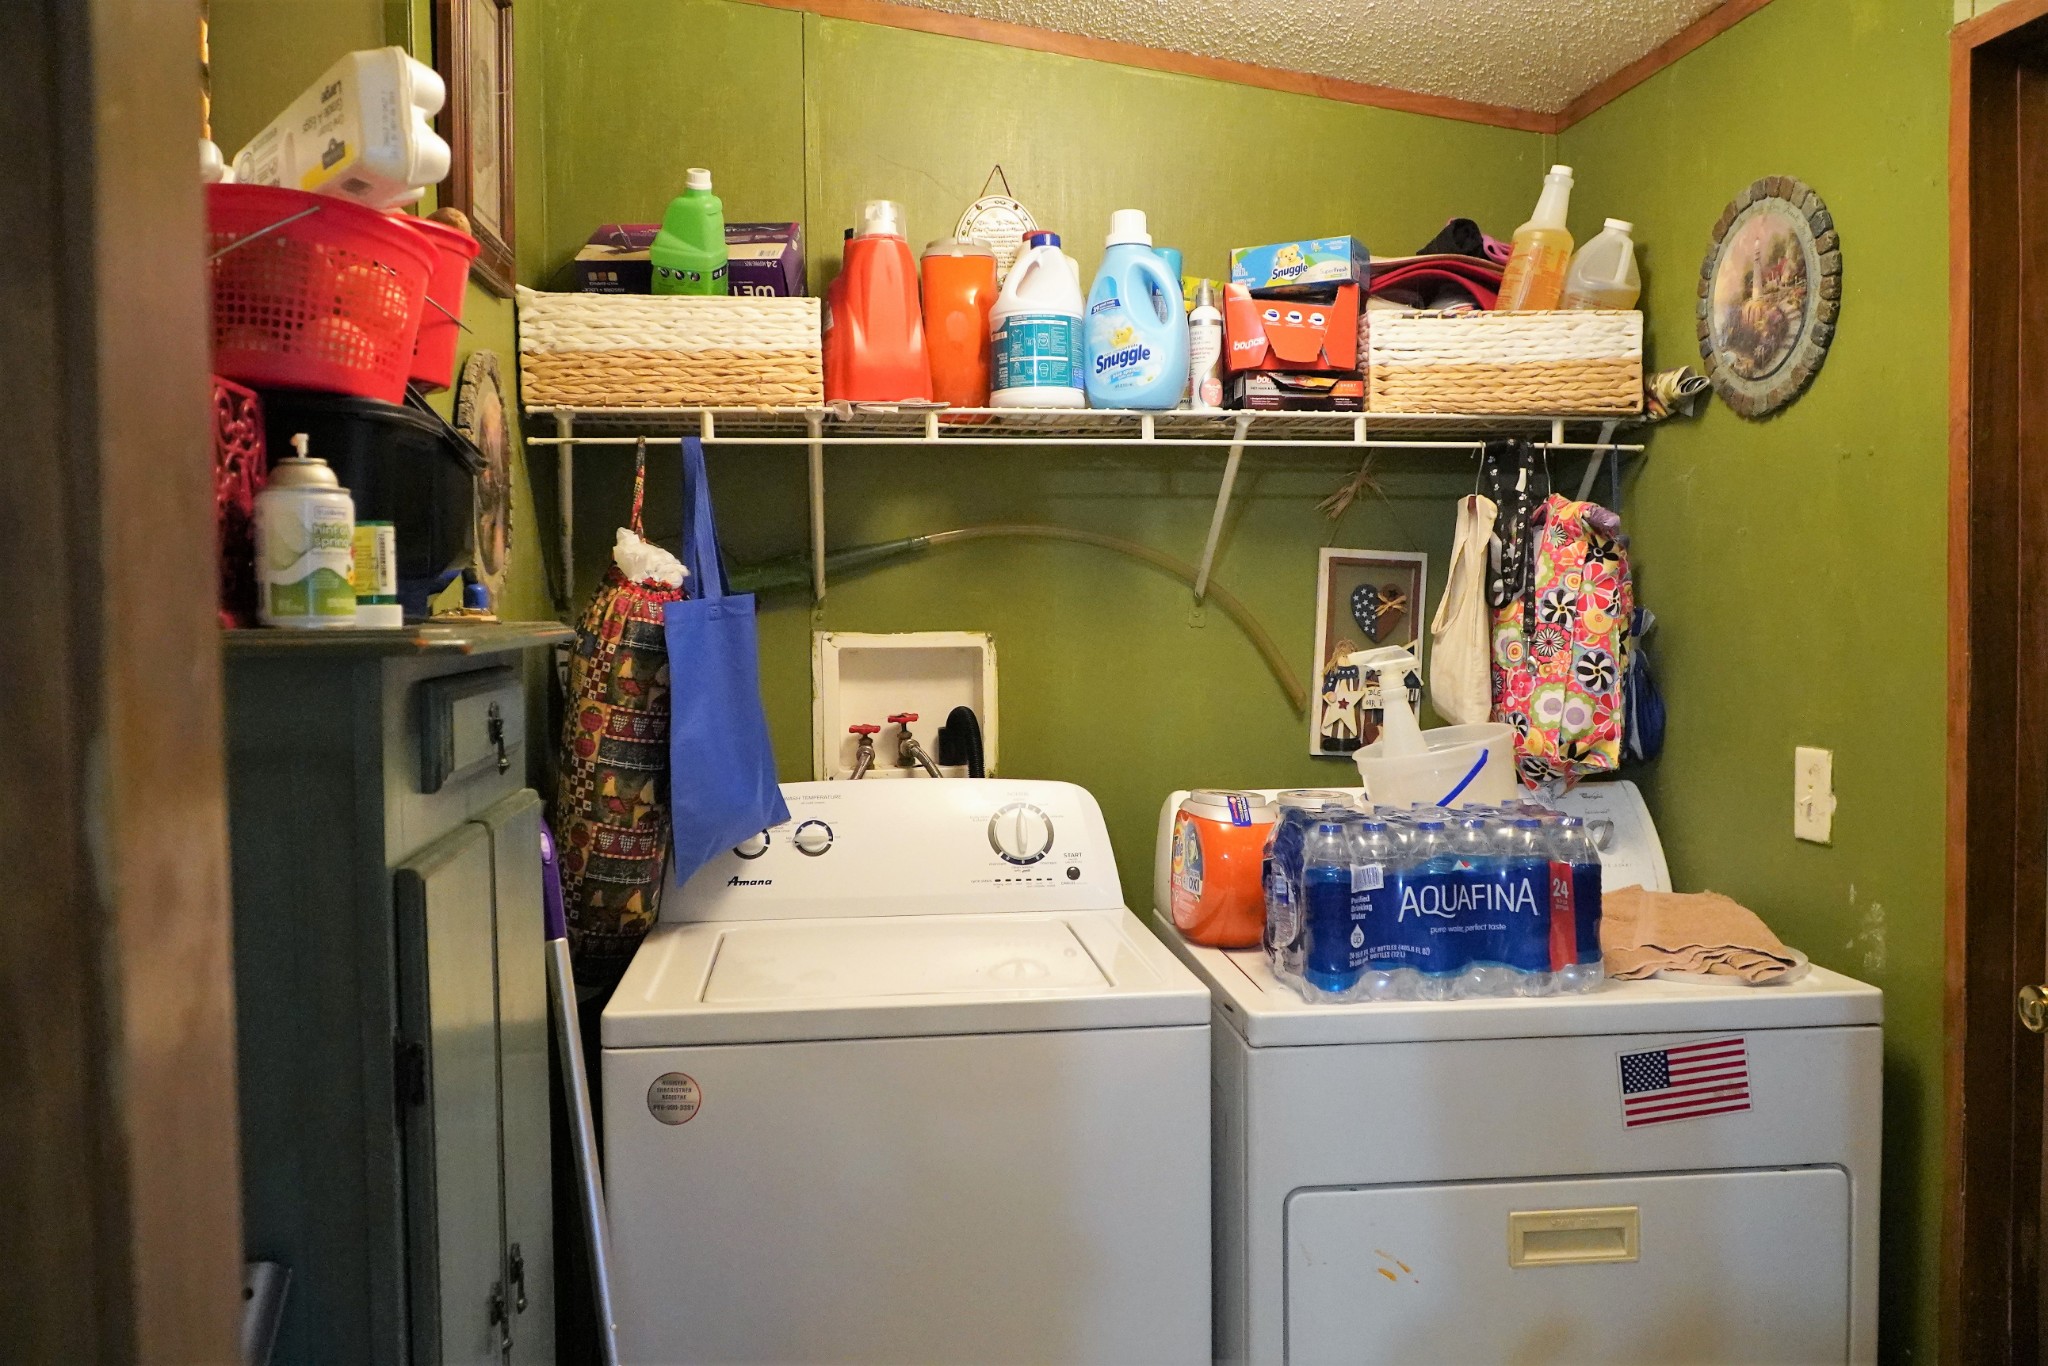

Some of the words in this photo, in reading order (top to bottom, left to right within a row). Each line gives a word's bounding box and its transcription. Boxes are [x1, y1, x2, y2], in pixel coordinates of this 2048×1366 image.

[766, 260, 778, 268] 24
[1272, 262, 1308, 280] Snuggle
[1233, 336, 1266, 351] bounce
[1096, 344, 1151, 374] Snuggle
[727, 876, 772, 886] Amana
[1553, 878, 1569, 899] 24
[1351, 894, 1371, 904] Purified
[1398, 877, 1539, 923] AQUAFINA
[1351, 904, 1373, 913] Drinking
[1430, 926, 1447, 935] pure
[1465, 923, 1487, 934] perfect
[1488, 923, 1507, 931] taste
